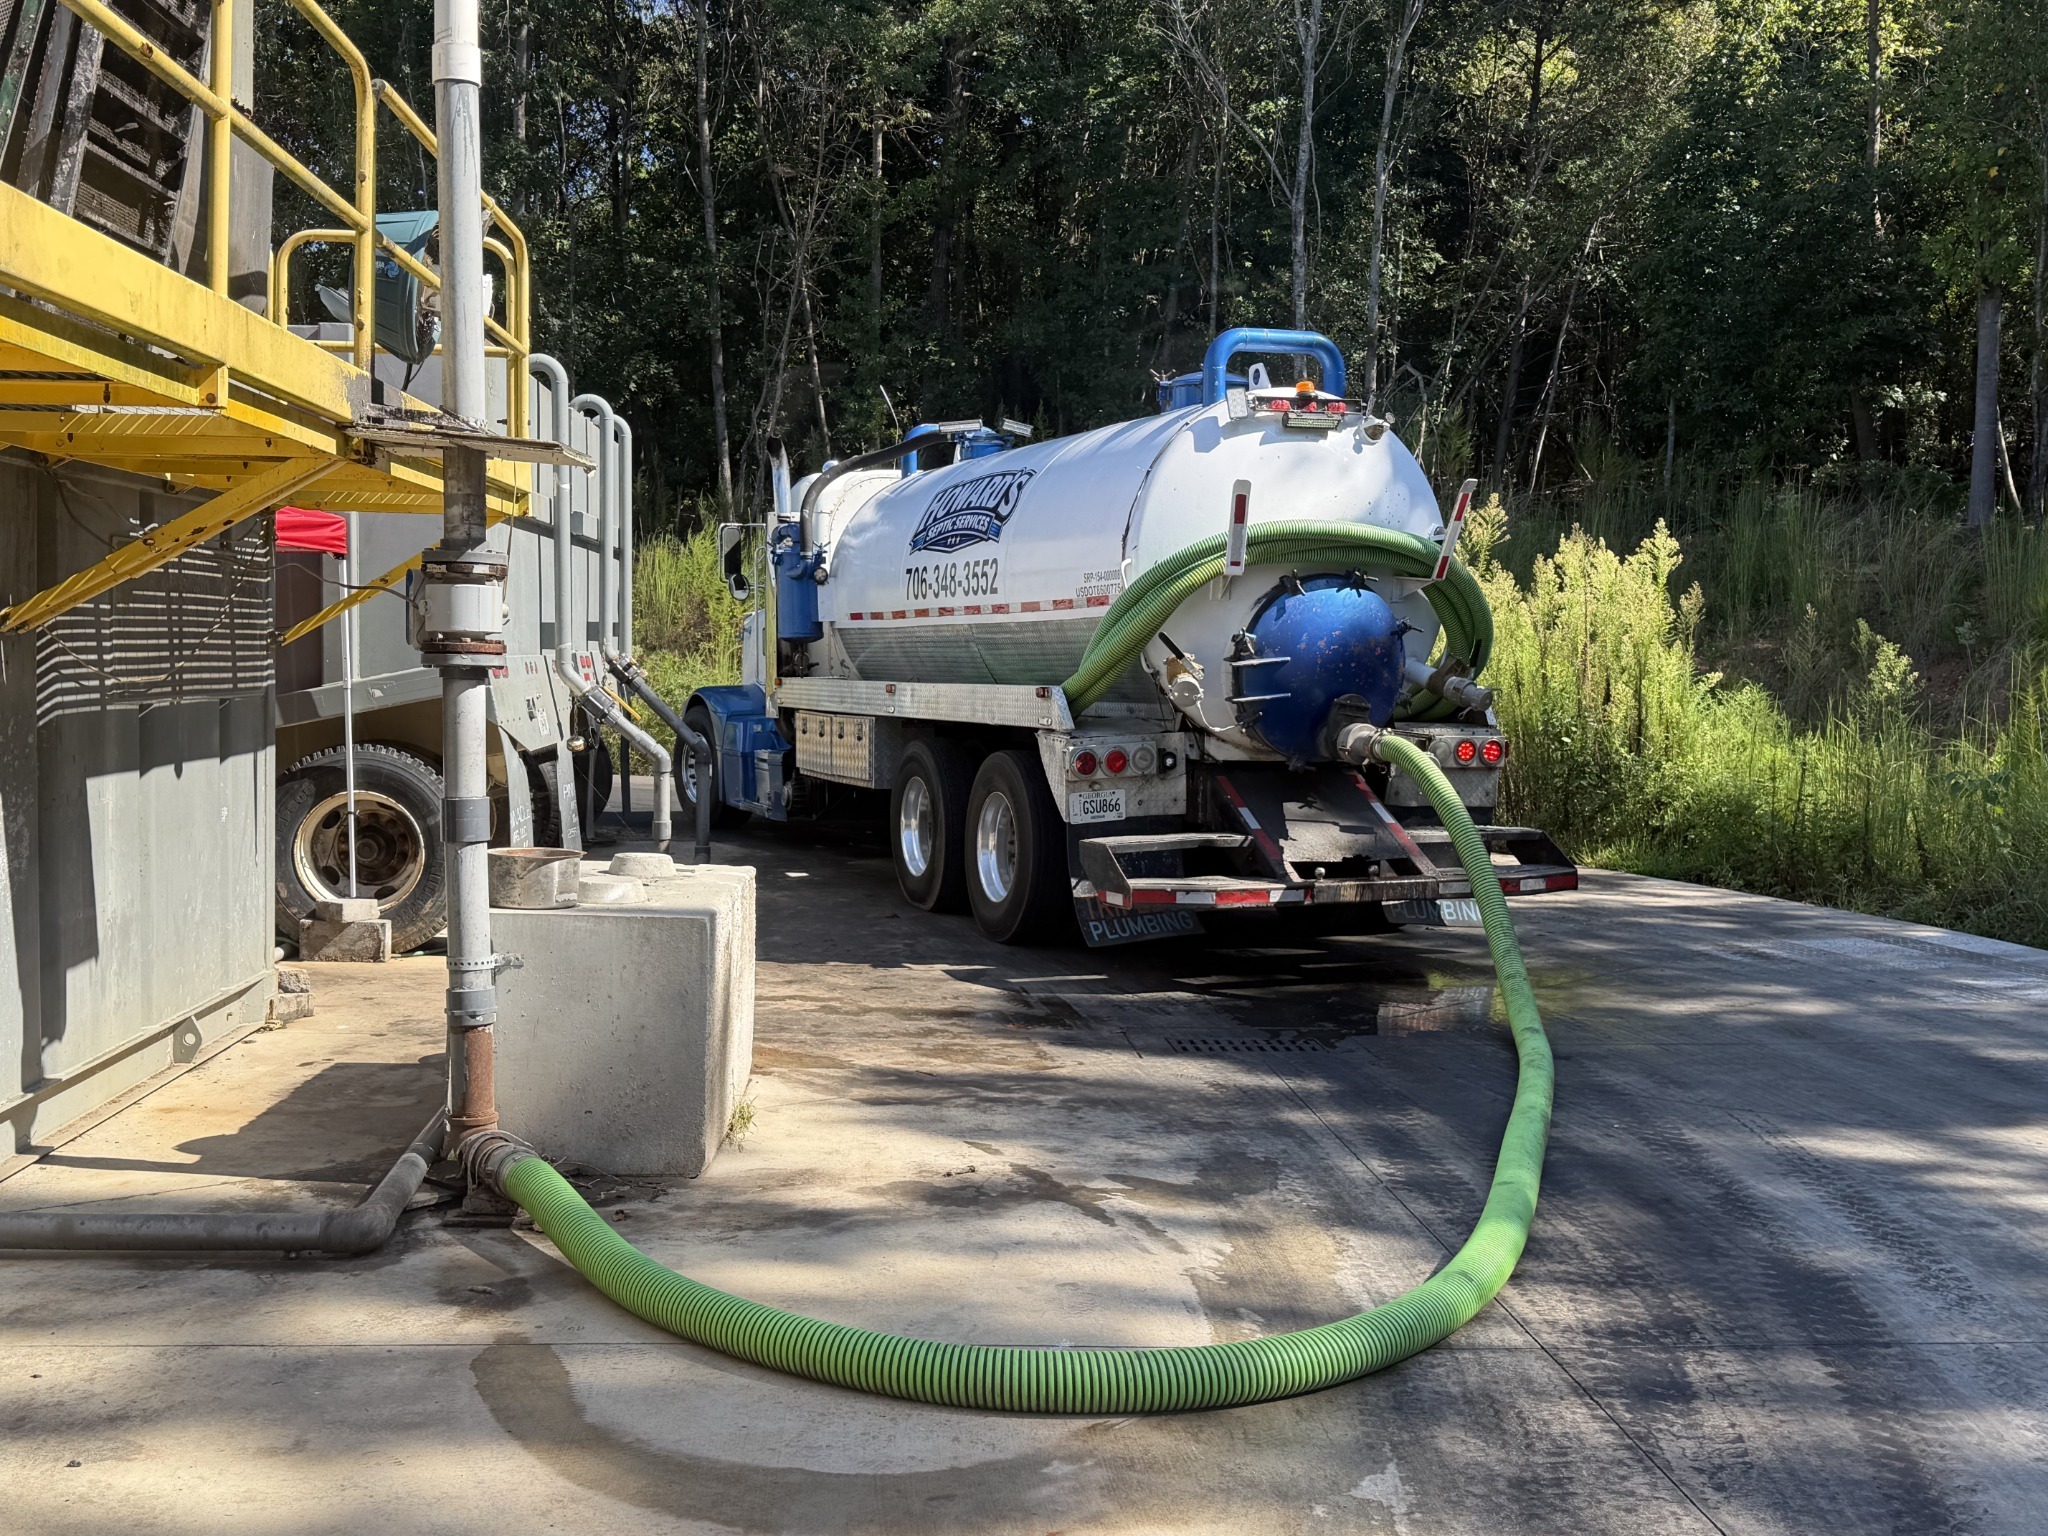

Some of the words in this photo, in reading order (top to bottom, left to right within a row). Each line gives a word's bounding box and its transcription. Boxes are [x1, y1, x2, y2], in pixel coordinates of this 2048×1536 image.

[918, 468, 1032, 530] HOWARD'S
[927, 521, 953, 539] SEPTIC
[954, 514, 990, 532] SERVICES
[906, 558, 998, 600] 706-348-3552
[1082, 791, 1113, 800] GEORGIA
[1083, 797, 1121, 814] GSU866
[1390, 900, 1483, 921] PLUMBIN
[1088, 911, 1194, 941] PLUMBING
